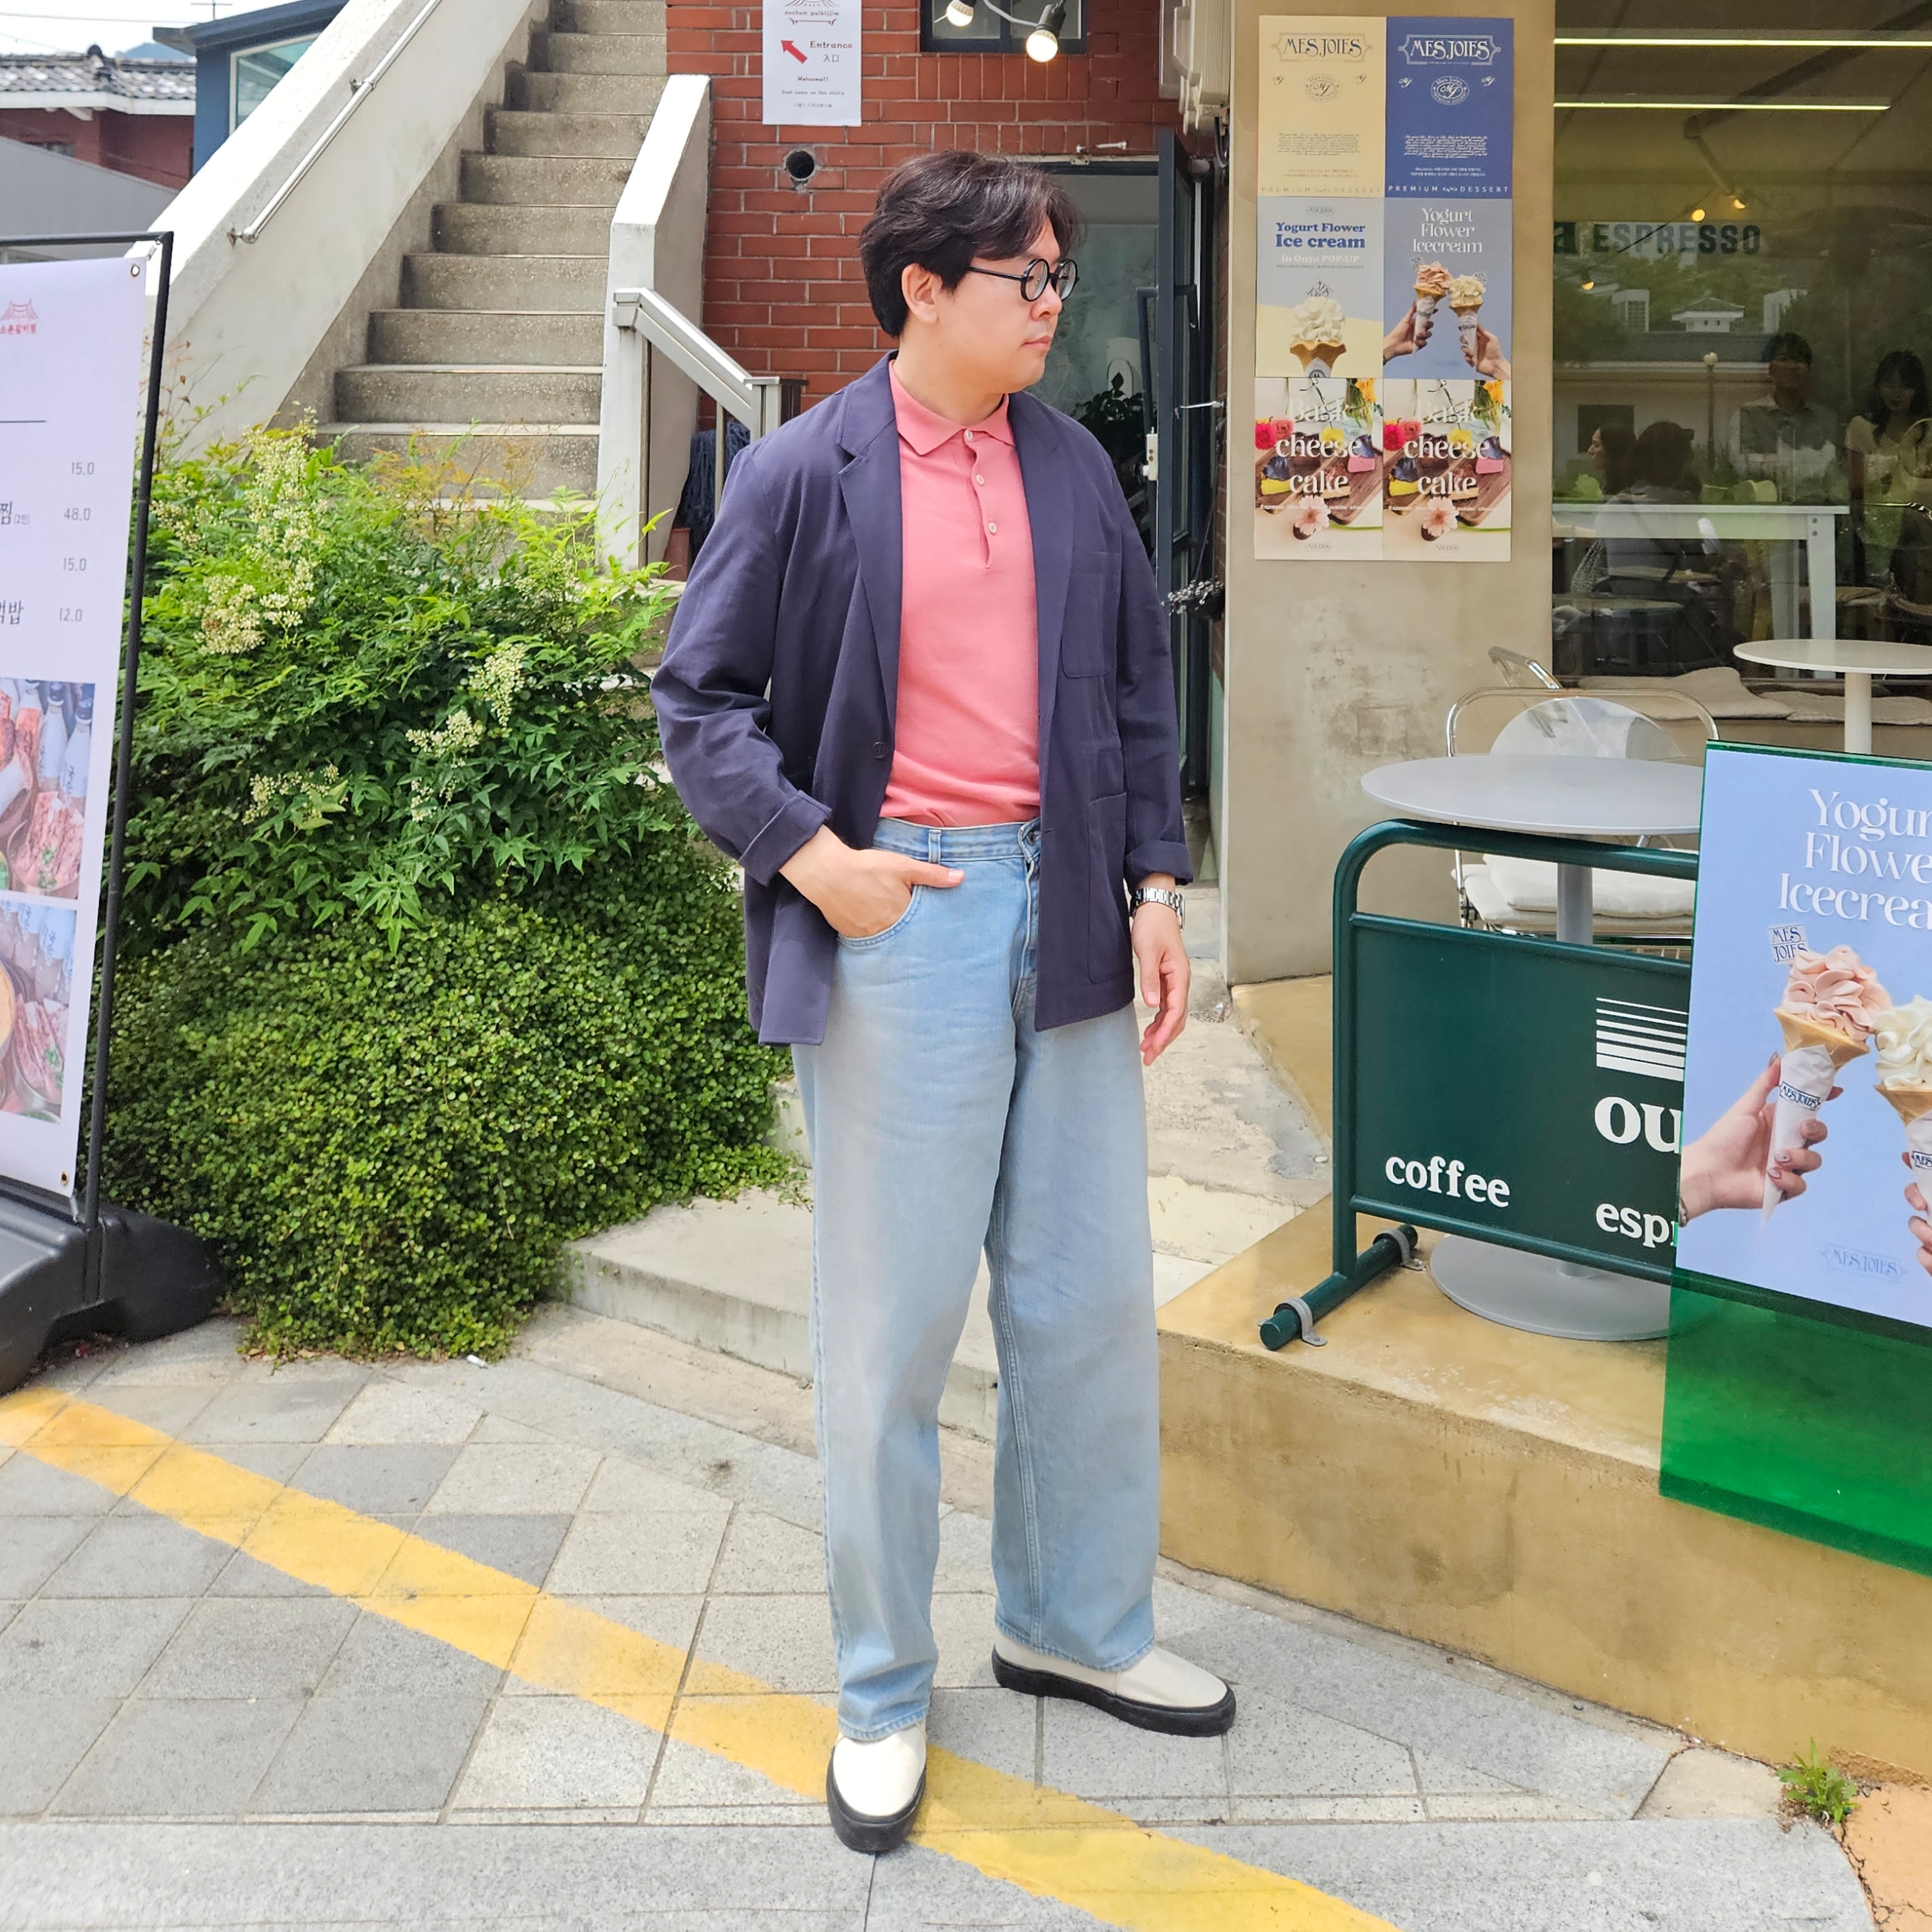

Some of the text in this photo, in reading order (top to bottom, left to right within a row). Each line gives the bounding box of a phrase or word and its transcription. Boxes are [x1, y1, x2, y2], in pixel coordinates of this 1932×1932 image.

[1283, 38, 1362, 57] MES JOIES
[1410, 40, 1490, 60] MES JOIES
[823, 54, 839, 63] 入口
[1421, 208, 1473, 225] Yogurt
[1276, 222, 1365, 234] Yogurt Flower
[1421, 223, 1475, 237] Flower
[1276, 234, 1365, 248] Ice cream
[1412, 238, 1483, 253] Icecream
[1593, 223, 1761, 256] ESPRESSO
[1281, 254, 1360, 264] In Ouya POP-UP
[1276, 434, 1362, 458] cheese
[1404, 436, 1490, 459] cheese
[71, 461, 95, 476] 15.0
[1289, 470, 1348, 494] cake
[1417, 472, 1477, 495] cake
[63, 507, 92, 522] 48.0
[63, 557, 87, 572] 15.0
[60, 607, 83, 623] 12.0
[1808, 788, 1932, 842] Yogur
[1803, 832, 1932, 884] Flowe
[1778, 872, 1932, 930] Icecrea
[1772, 926, 1802, 943] MES
[1385, 1155, 1510, 1208] coffee
[1831, 1249, 1898, 1279] MES JOIES
